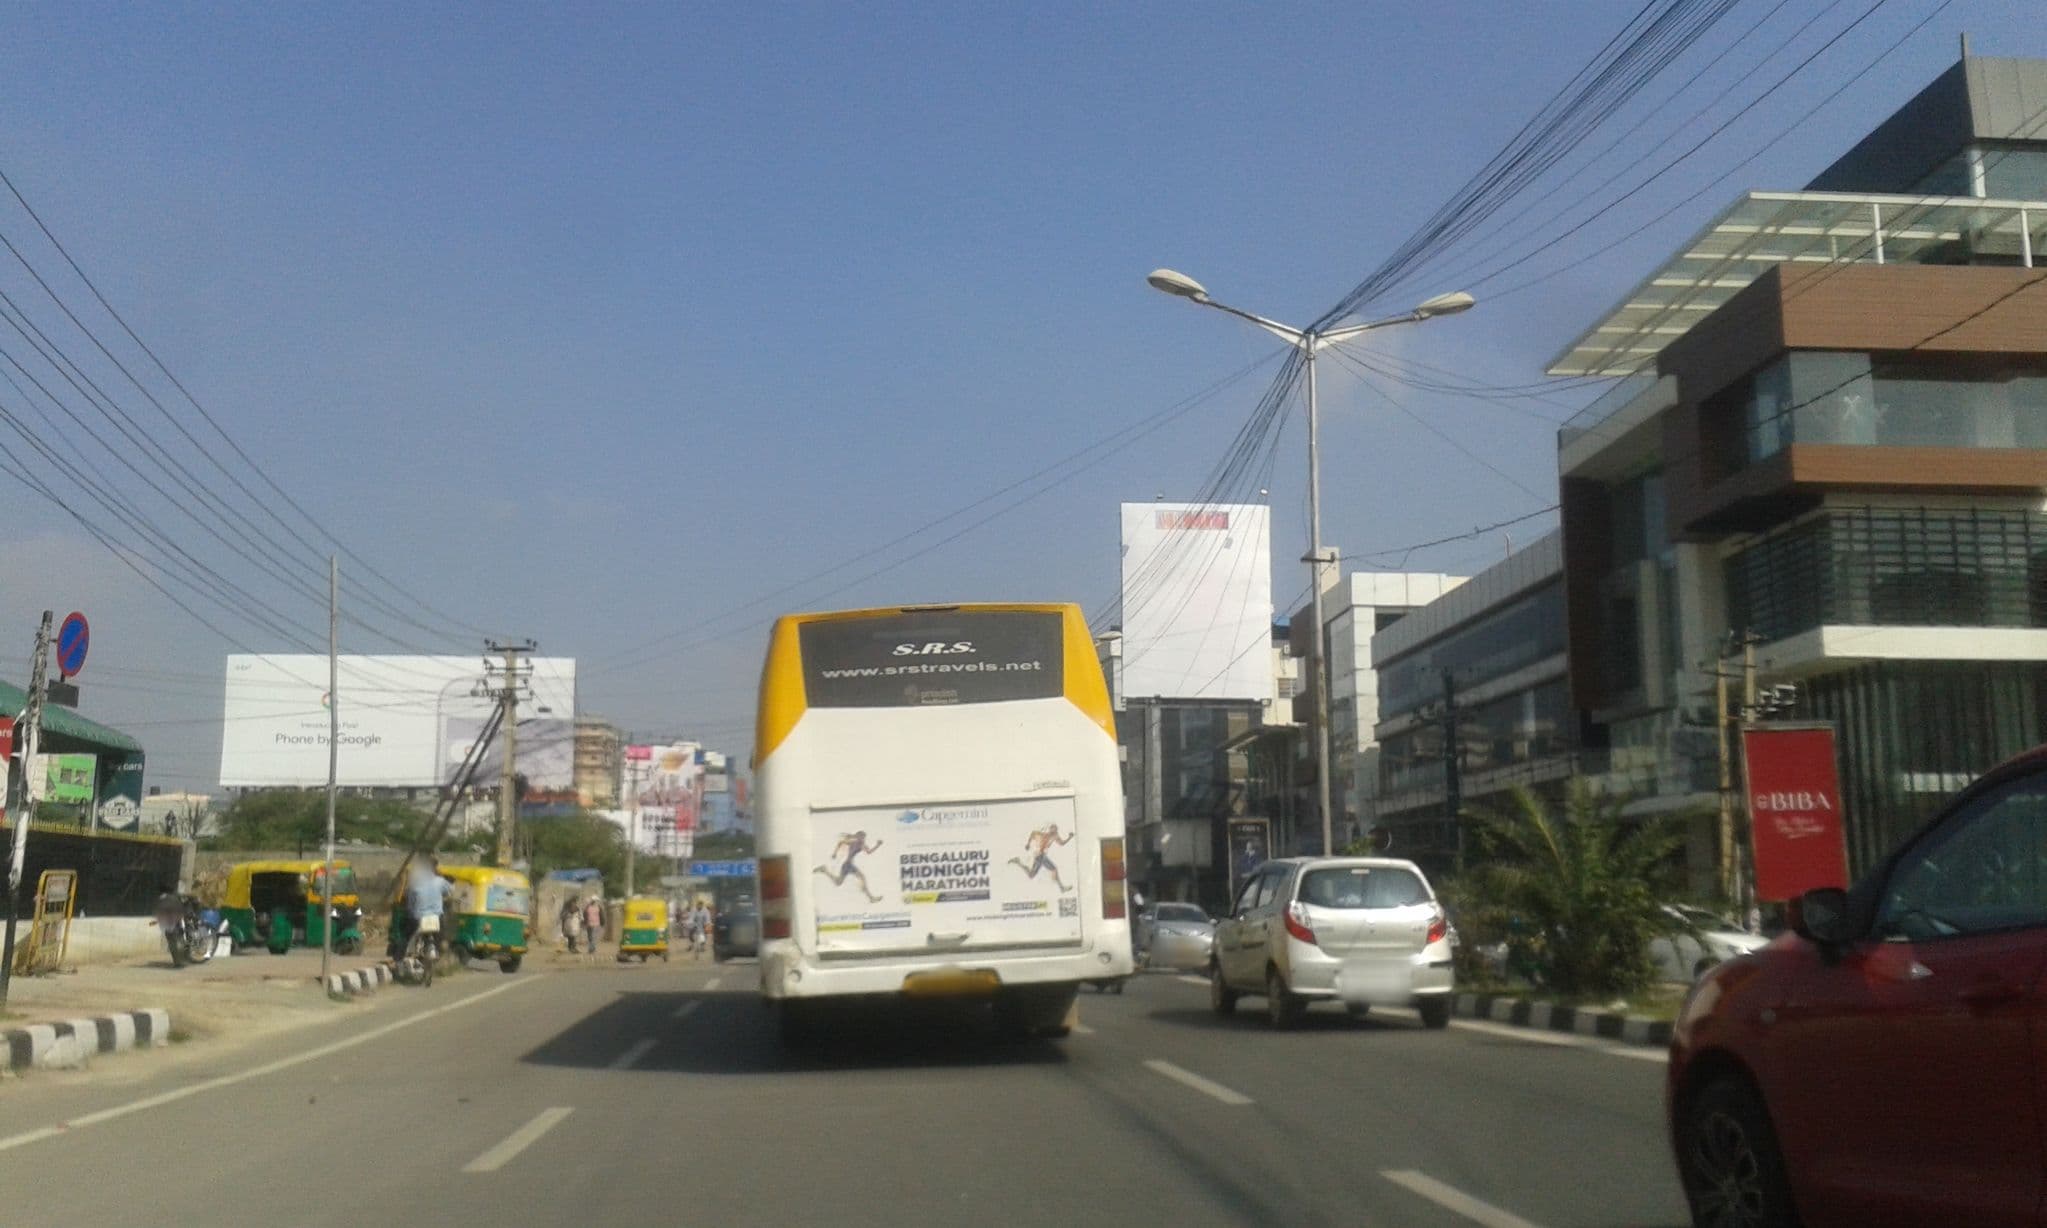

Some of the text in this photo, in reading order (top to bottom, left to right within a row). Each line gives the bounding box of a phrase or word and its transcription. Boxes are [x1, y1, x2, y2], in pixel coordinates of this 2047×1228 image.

[892, 641, 977, 657] S.R.S.
[822, 660, 1042, 679] www.srstravels.net
[275, 732, 382, 748] Phone by Google
[1771, 792, 1831, 812] BIBA
[900, 850, 989, 864] BENGALURU
[901, 862, 989, 879] MIDNIGHT
[901, 877, 990, 892] MARATHON
